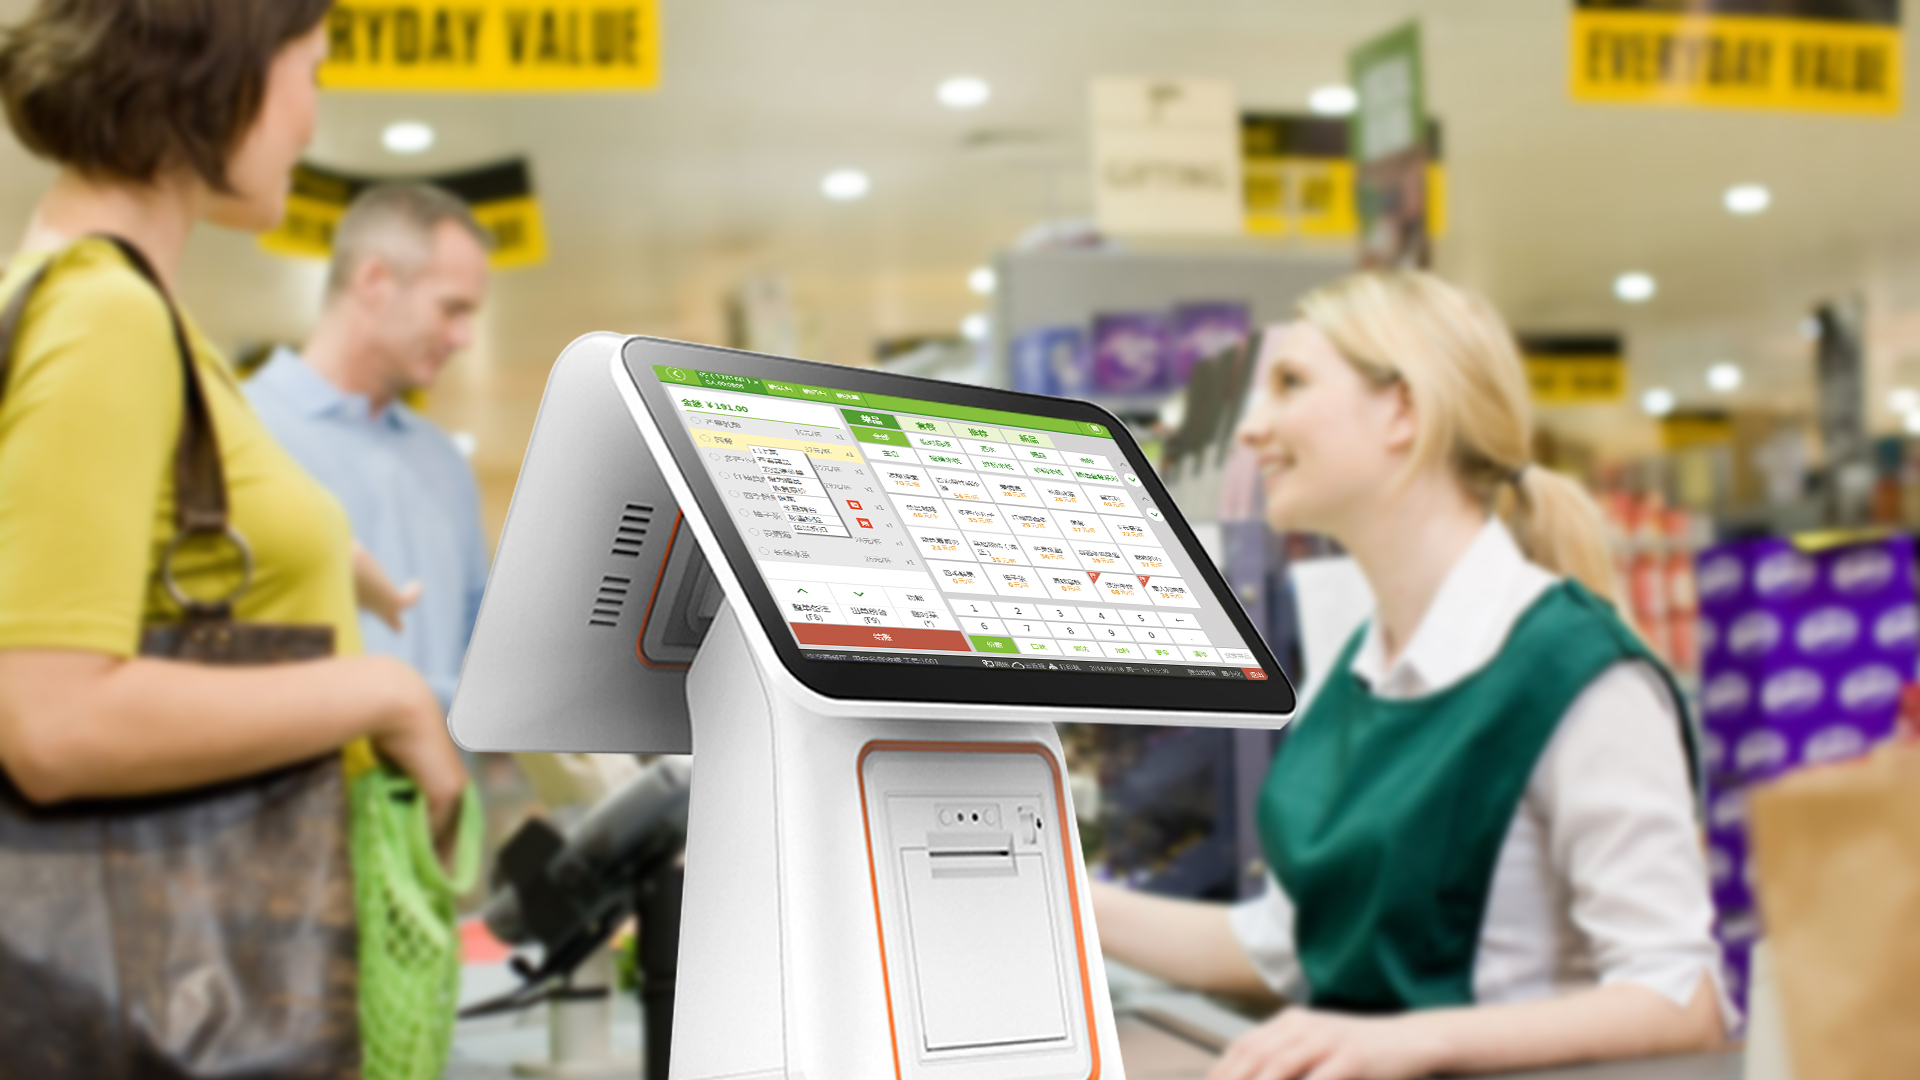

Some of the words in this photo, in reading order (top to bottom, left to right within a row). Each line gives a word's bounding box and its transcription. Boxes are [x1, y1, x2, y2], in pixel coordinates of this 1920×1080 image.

[330, 7, 483, 67] RYDAY
[503, 9, 638, 68] VALUE
[1586, 28, 1774, 89] EVERYDAY
[1791, 40, 1890, 94] VALUE
